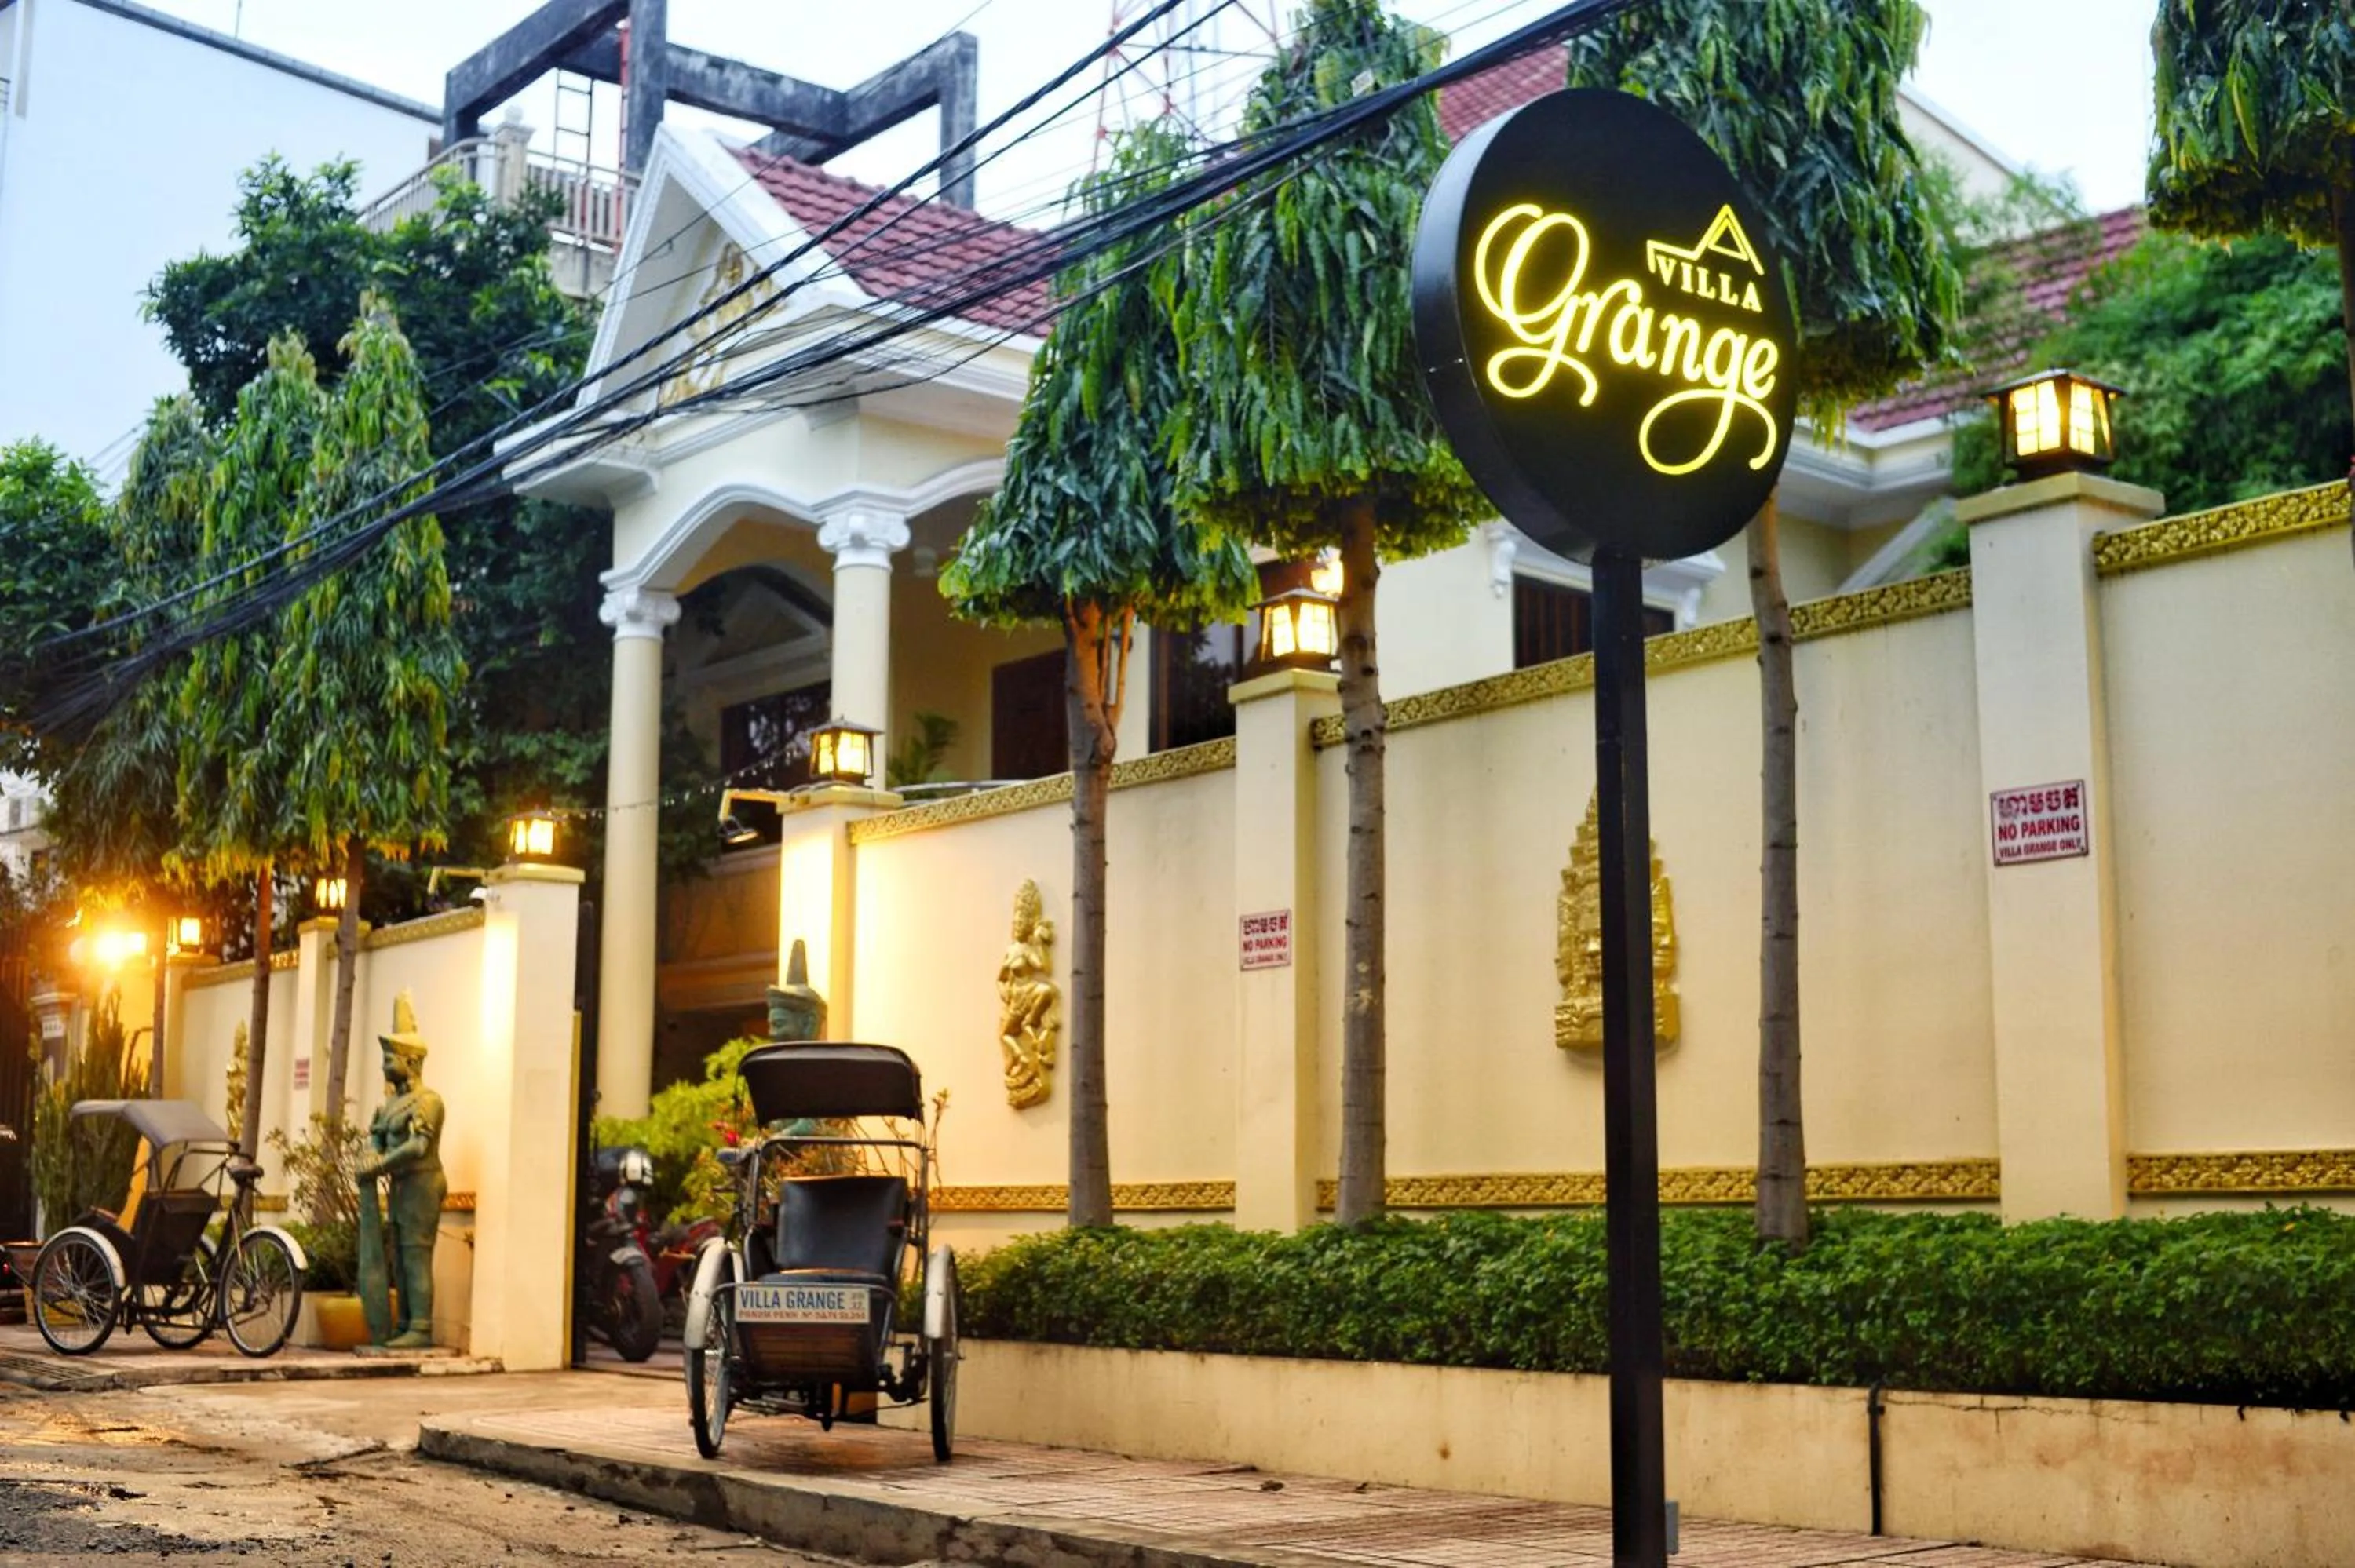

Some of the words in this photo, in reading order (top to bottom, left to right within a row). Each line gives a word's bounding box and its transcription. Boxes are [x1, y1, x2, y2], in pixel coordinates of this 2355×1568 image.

[1654, 253, 1763, 313] VILLA
[1474, 203, 1780, 476] Grange
[1998, 823, 2017, 841] NO
[2021, 815, 2080, 838] PARKING
[1999, 845, 2022, 857] VILLA
[1243, 940, 1253, 952] NO
[1255, 935, 1287, 950] PARKING
[739, 1289, 781, 1308] VILLA
[786, 1290, 845, 1309] GRANGE
